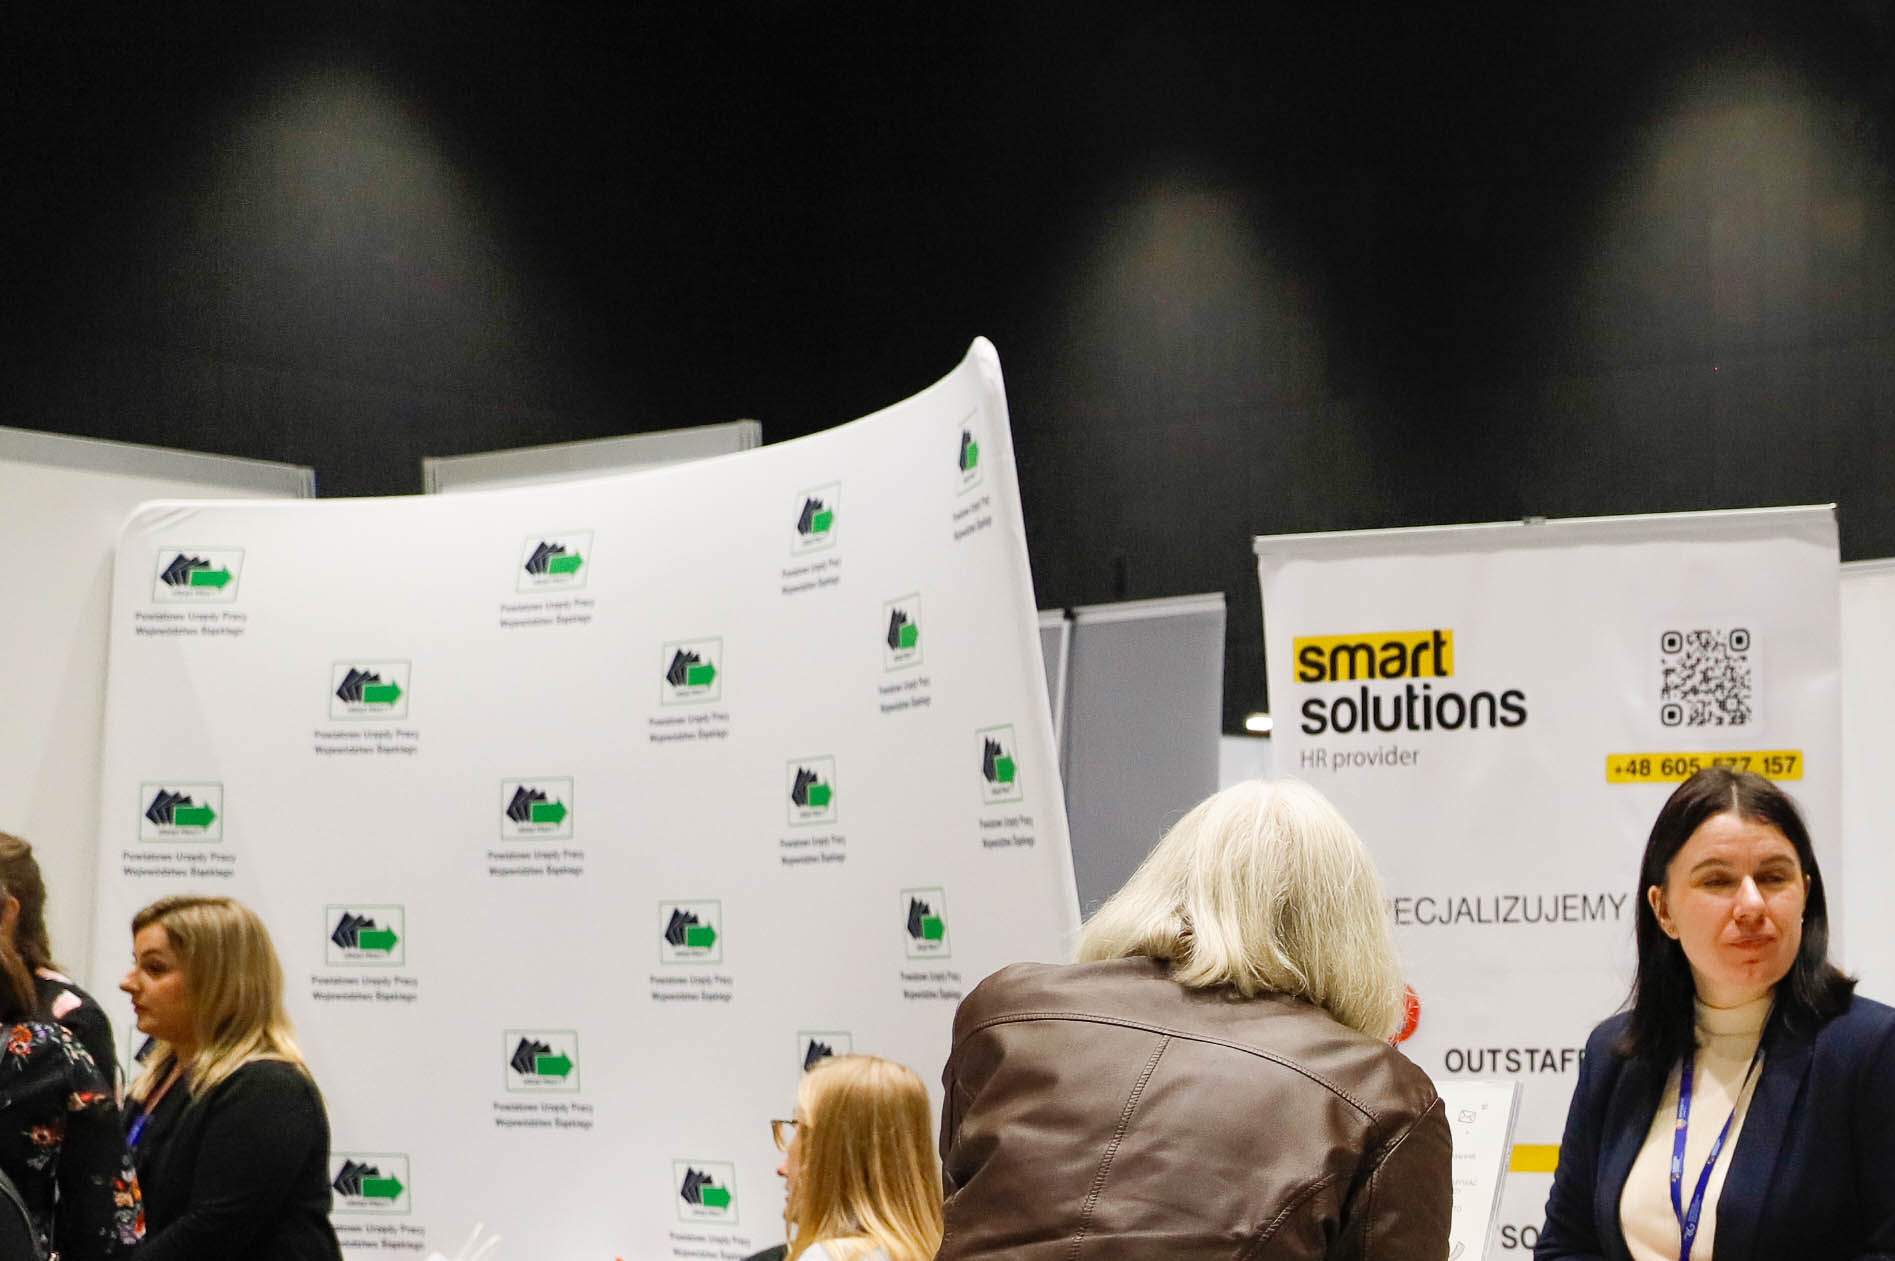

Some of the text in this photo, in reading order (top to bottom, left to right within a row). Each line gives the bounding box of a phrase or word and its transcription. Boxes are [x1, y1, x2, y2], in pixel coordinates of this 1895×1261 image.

[1298, 629, 1449, 683] smart
[1300, 684, 1528, 735] solutions
[1300, 746, 1420, 772] HR provider
[1661, 757, 1700, 777] 605
[1763, 755, 1797, 775] 157
[1392, 892, 1628, 926] ECJALIZUJEMY
